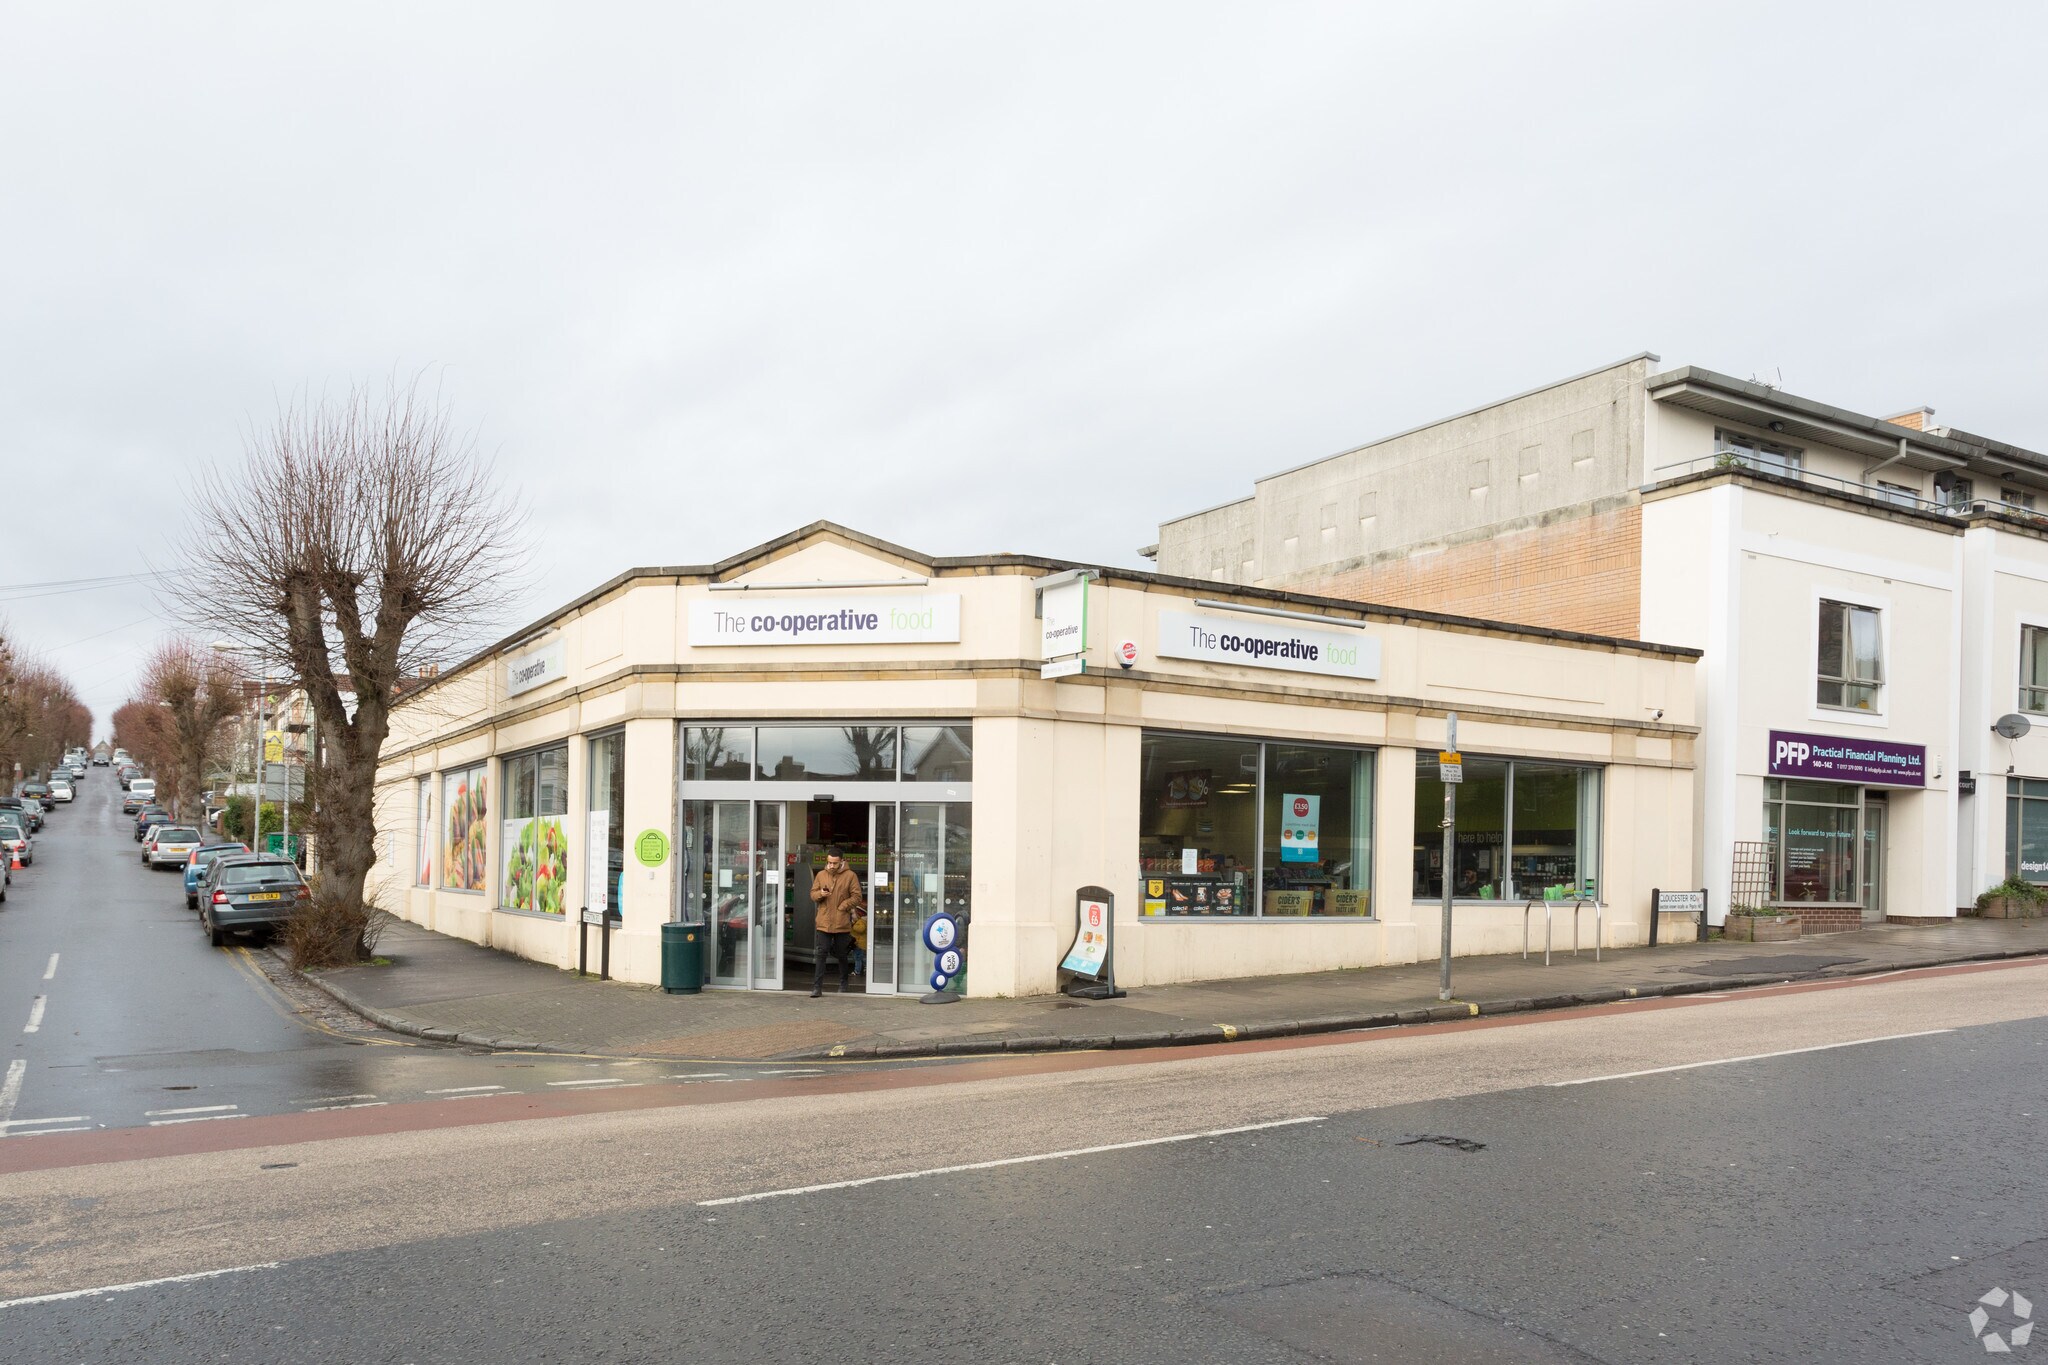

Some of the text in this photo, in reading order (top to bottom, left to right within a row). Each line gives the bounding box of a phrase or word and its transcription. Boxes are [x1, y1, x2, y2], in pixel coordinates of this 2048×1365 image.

[714, 608, 933, 636] The co-operative food
[1046, 624, 1078, 640] co-operative
[1190, 626, 1358, 666] The co-operative food
[1776, 740, 1922, 767] PFP Practical Financial Planning Ltd.
[1812, 760, 1833, 769] 140-142
[1458, 832, 1503, 844] here to help
[1278, 896, 1300, 905] CIDER'S
[1336, 894, 1358, 904] CIDER'S
